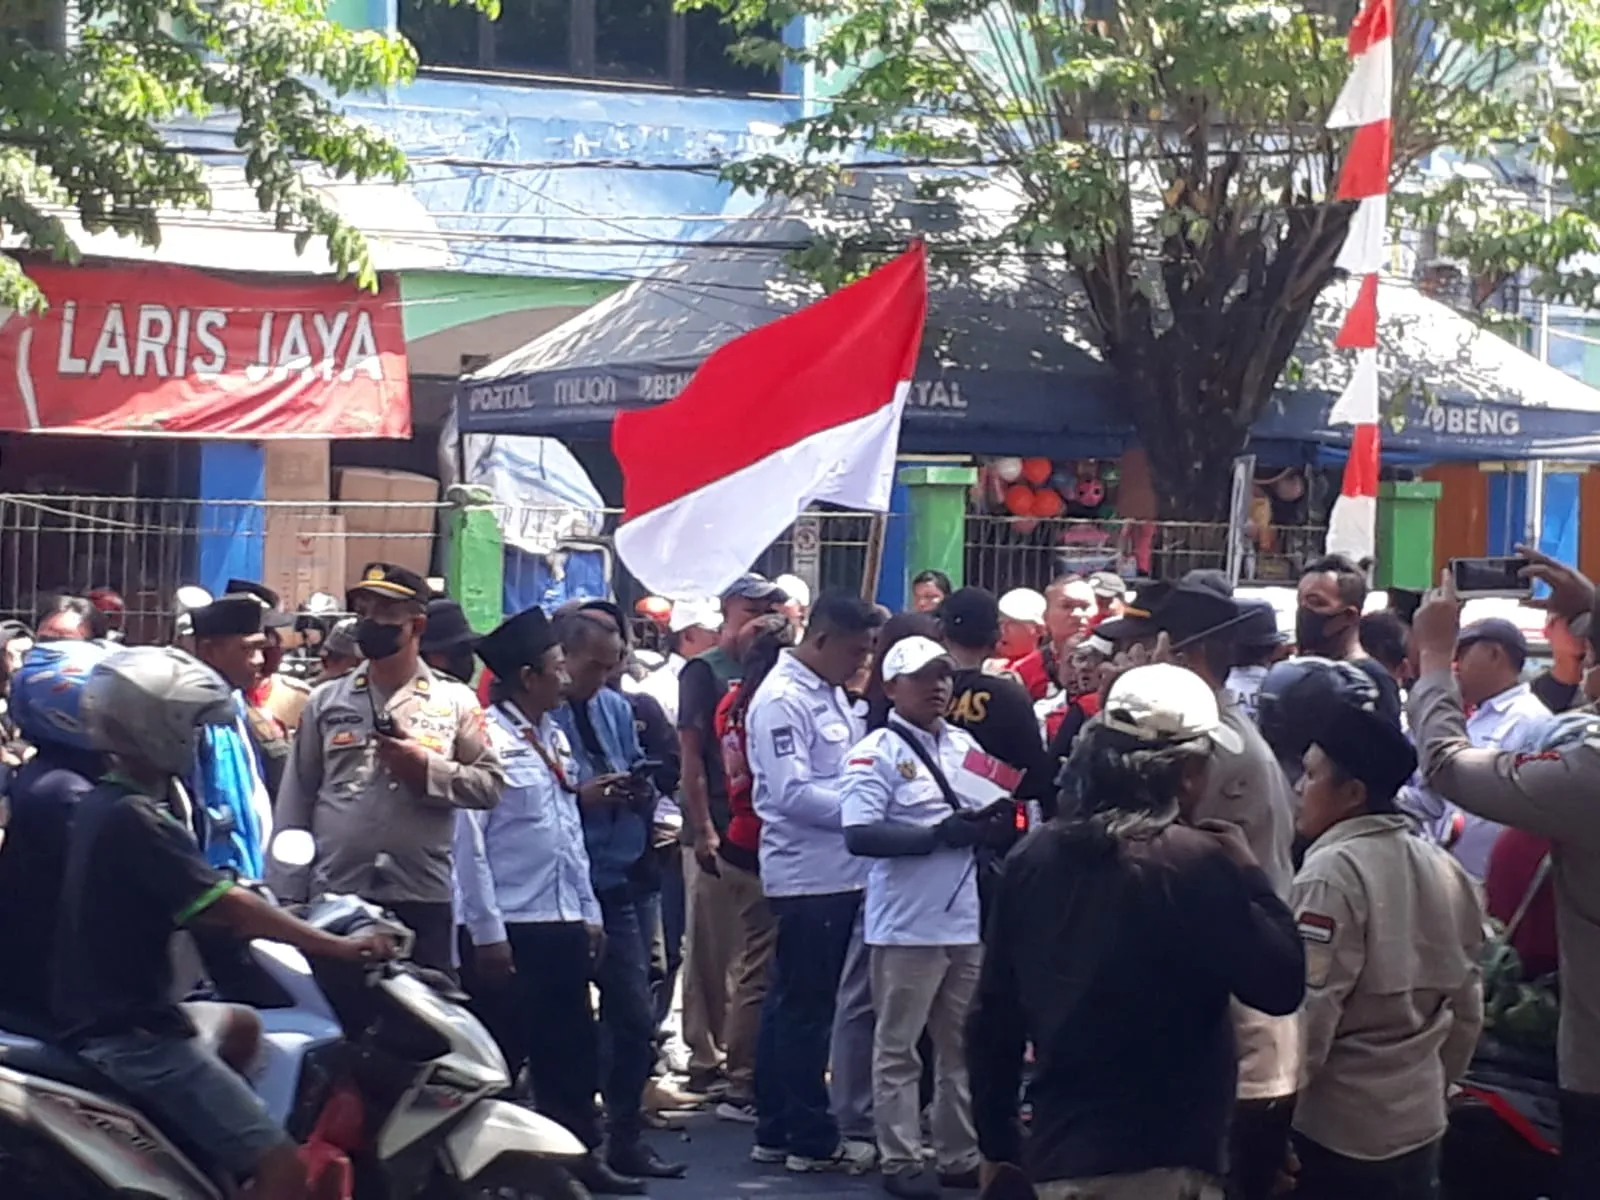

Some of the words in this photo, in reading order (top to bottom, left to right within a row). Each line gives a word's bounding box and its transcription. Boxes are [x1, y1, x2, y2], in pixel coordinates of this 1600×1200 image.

[57, 300, 228, 380] LARIS
[244, 309, 383, 381] JAYA
[469, 383, 535, 411] PORTAL
